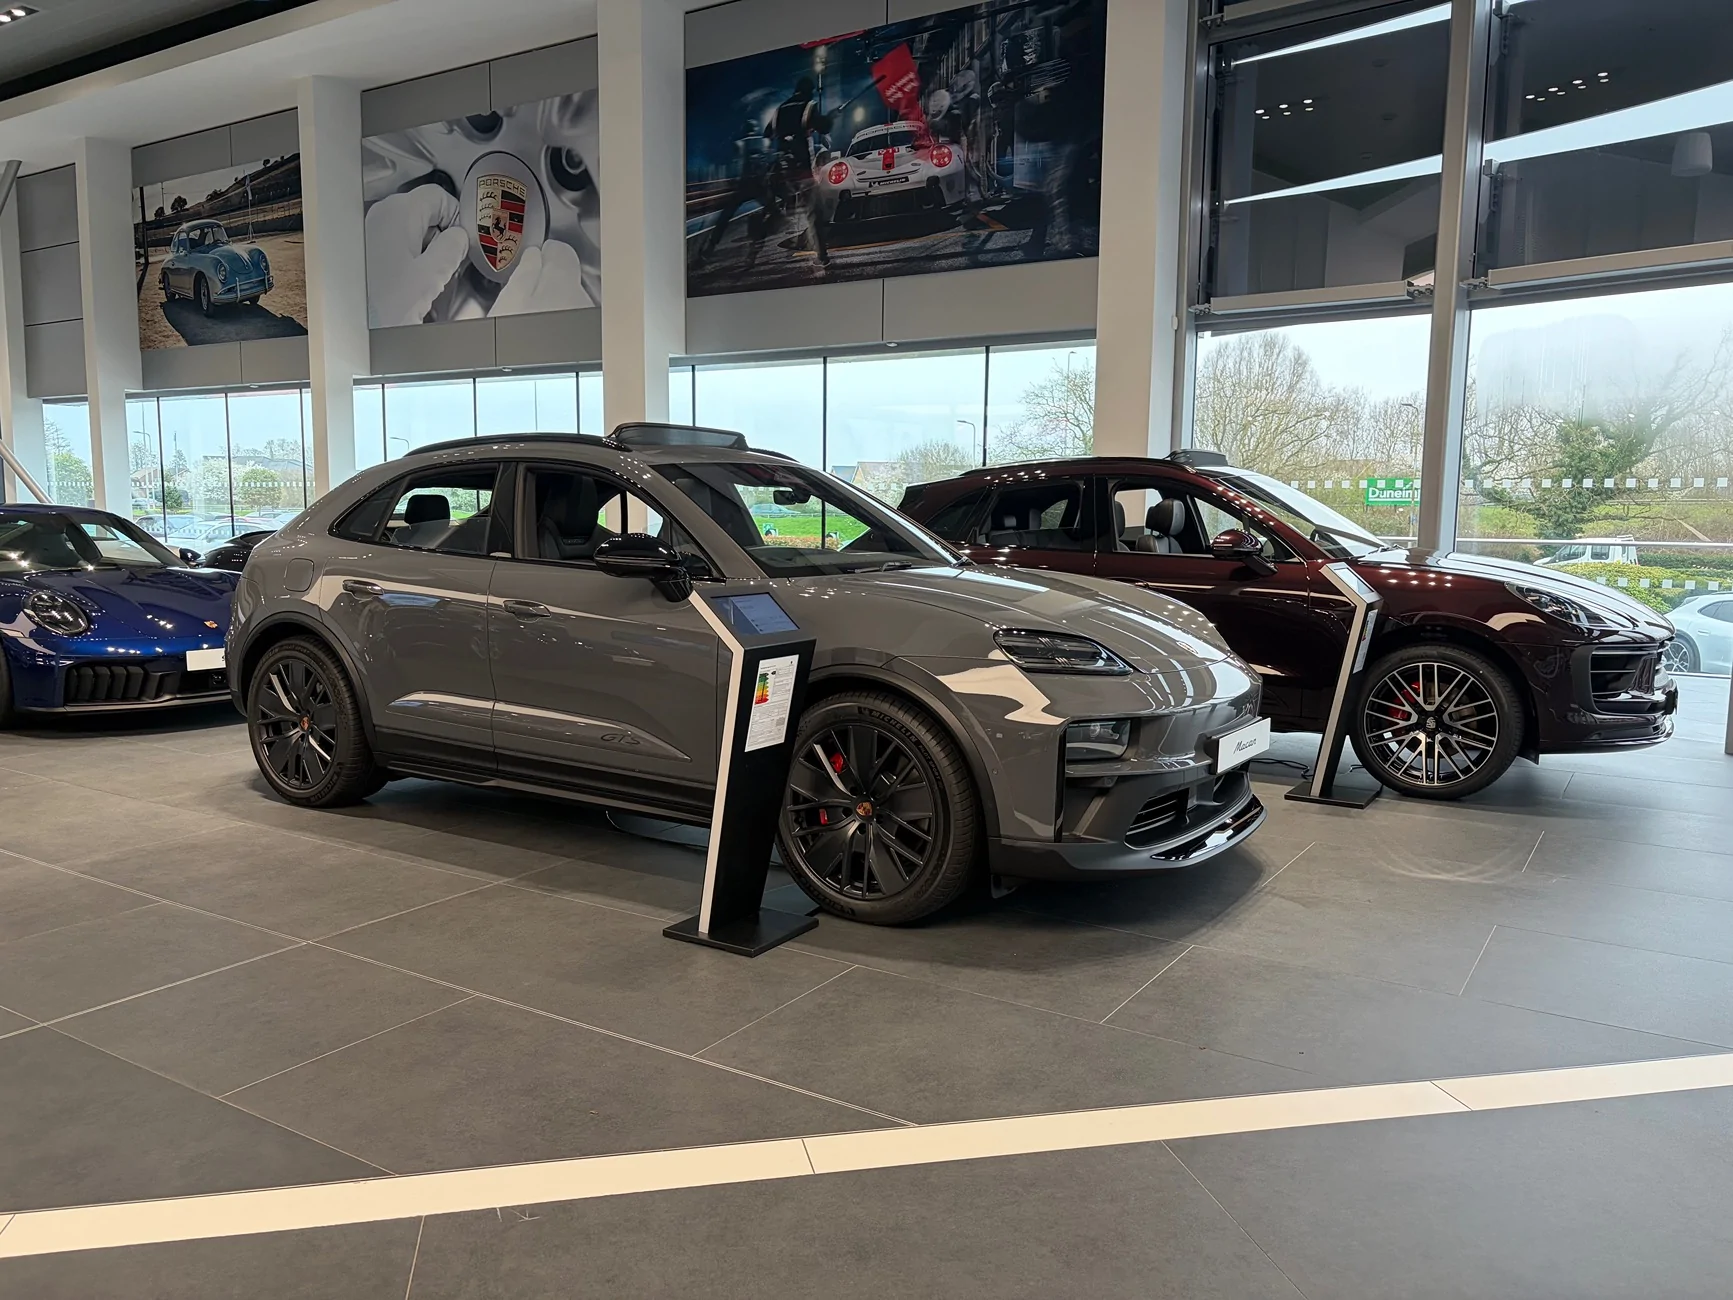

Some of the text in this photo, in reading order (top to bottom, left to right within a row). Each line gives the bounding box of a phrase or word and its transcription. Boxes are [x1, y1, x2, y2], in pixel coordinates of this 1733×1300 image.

[479, 178, 526, 198] PORSCHE
[871, 710, 918, 742] MICHELIN
[601, 733, 641, 745] GTS
[1233, 738, 1257, 755] Macan
